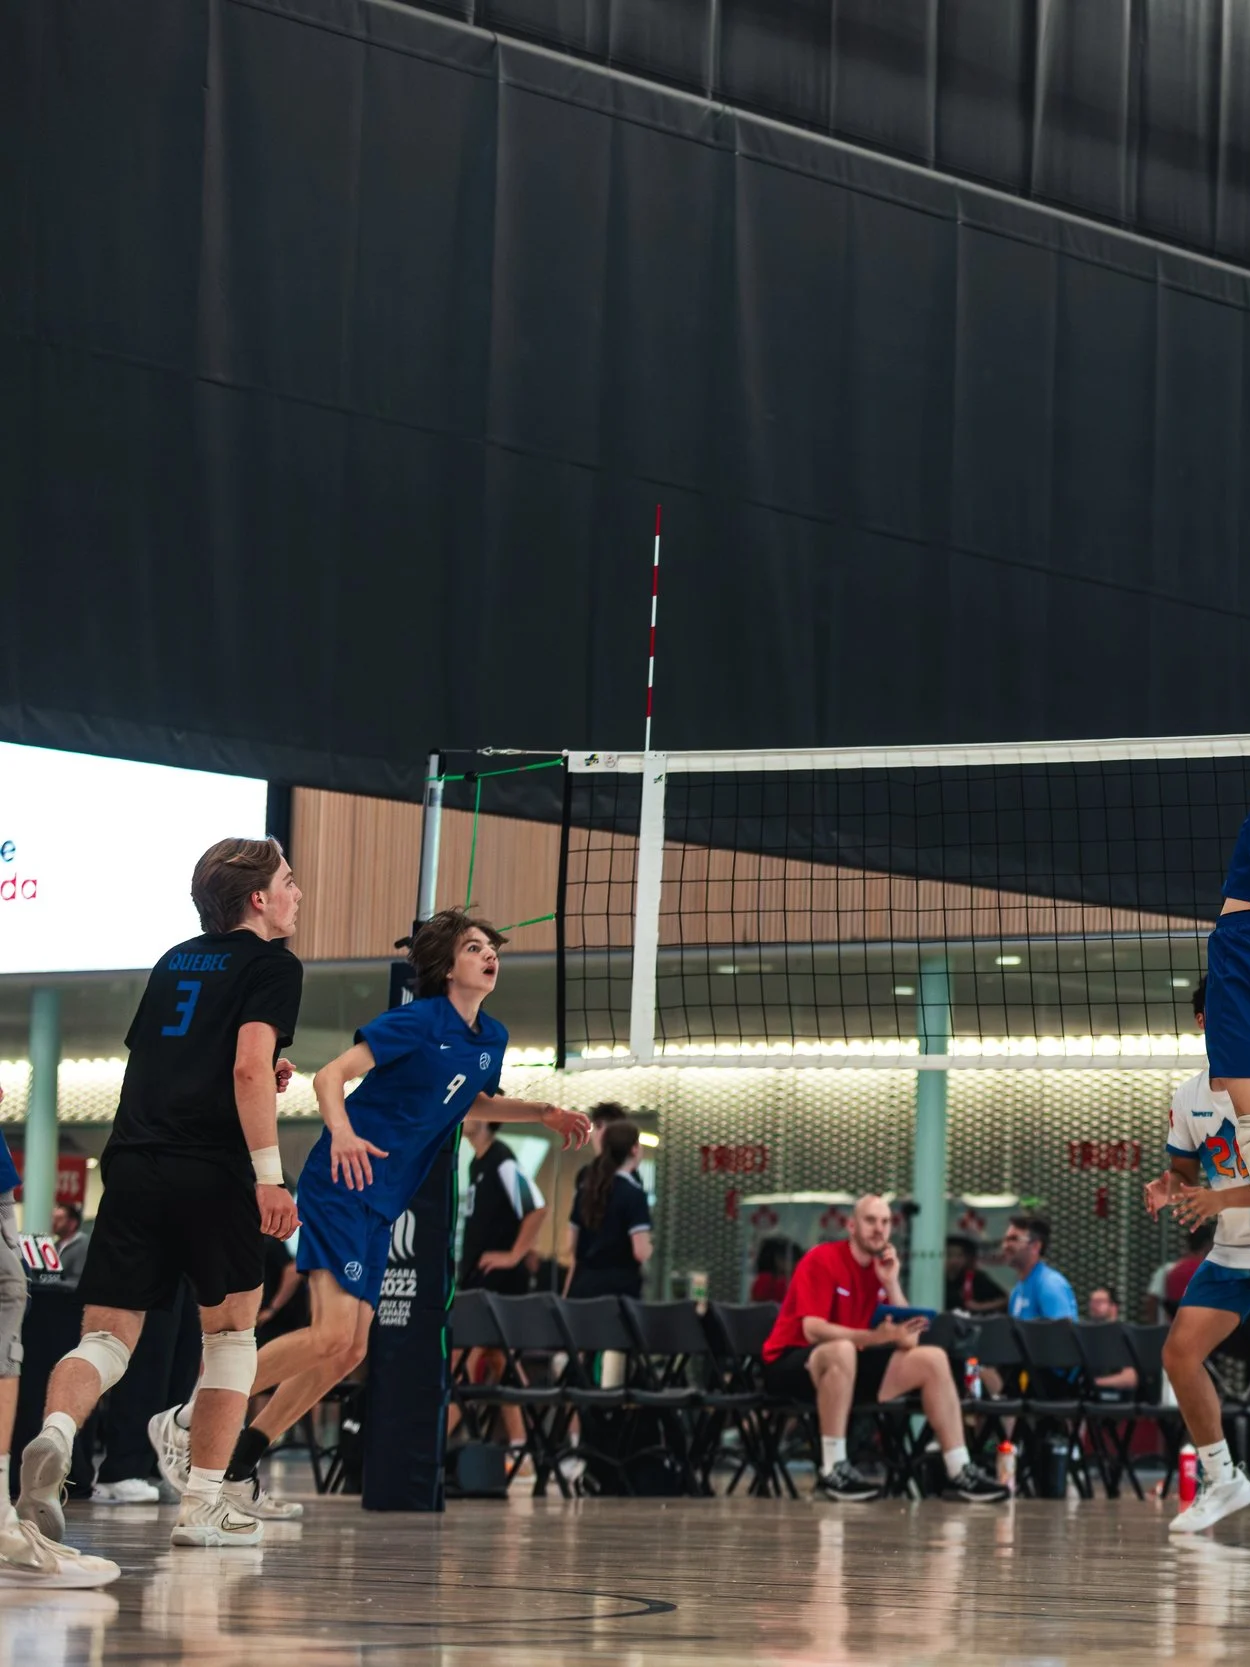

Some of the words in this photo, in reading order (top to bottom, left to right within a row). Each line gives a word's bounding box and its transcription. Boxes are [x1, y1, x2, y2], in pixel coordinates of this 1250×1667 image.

[168, 952, 232, 972] QUEBEC
[161, 979, 204, 1037] 3
[443, 1073, 467, 1104] 9
[384, 1268, 417, 1278] AGARA
